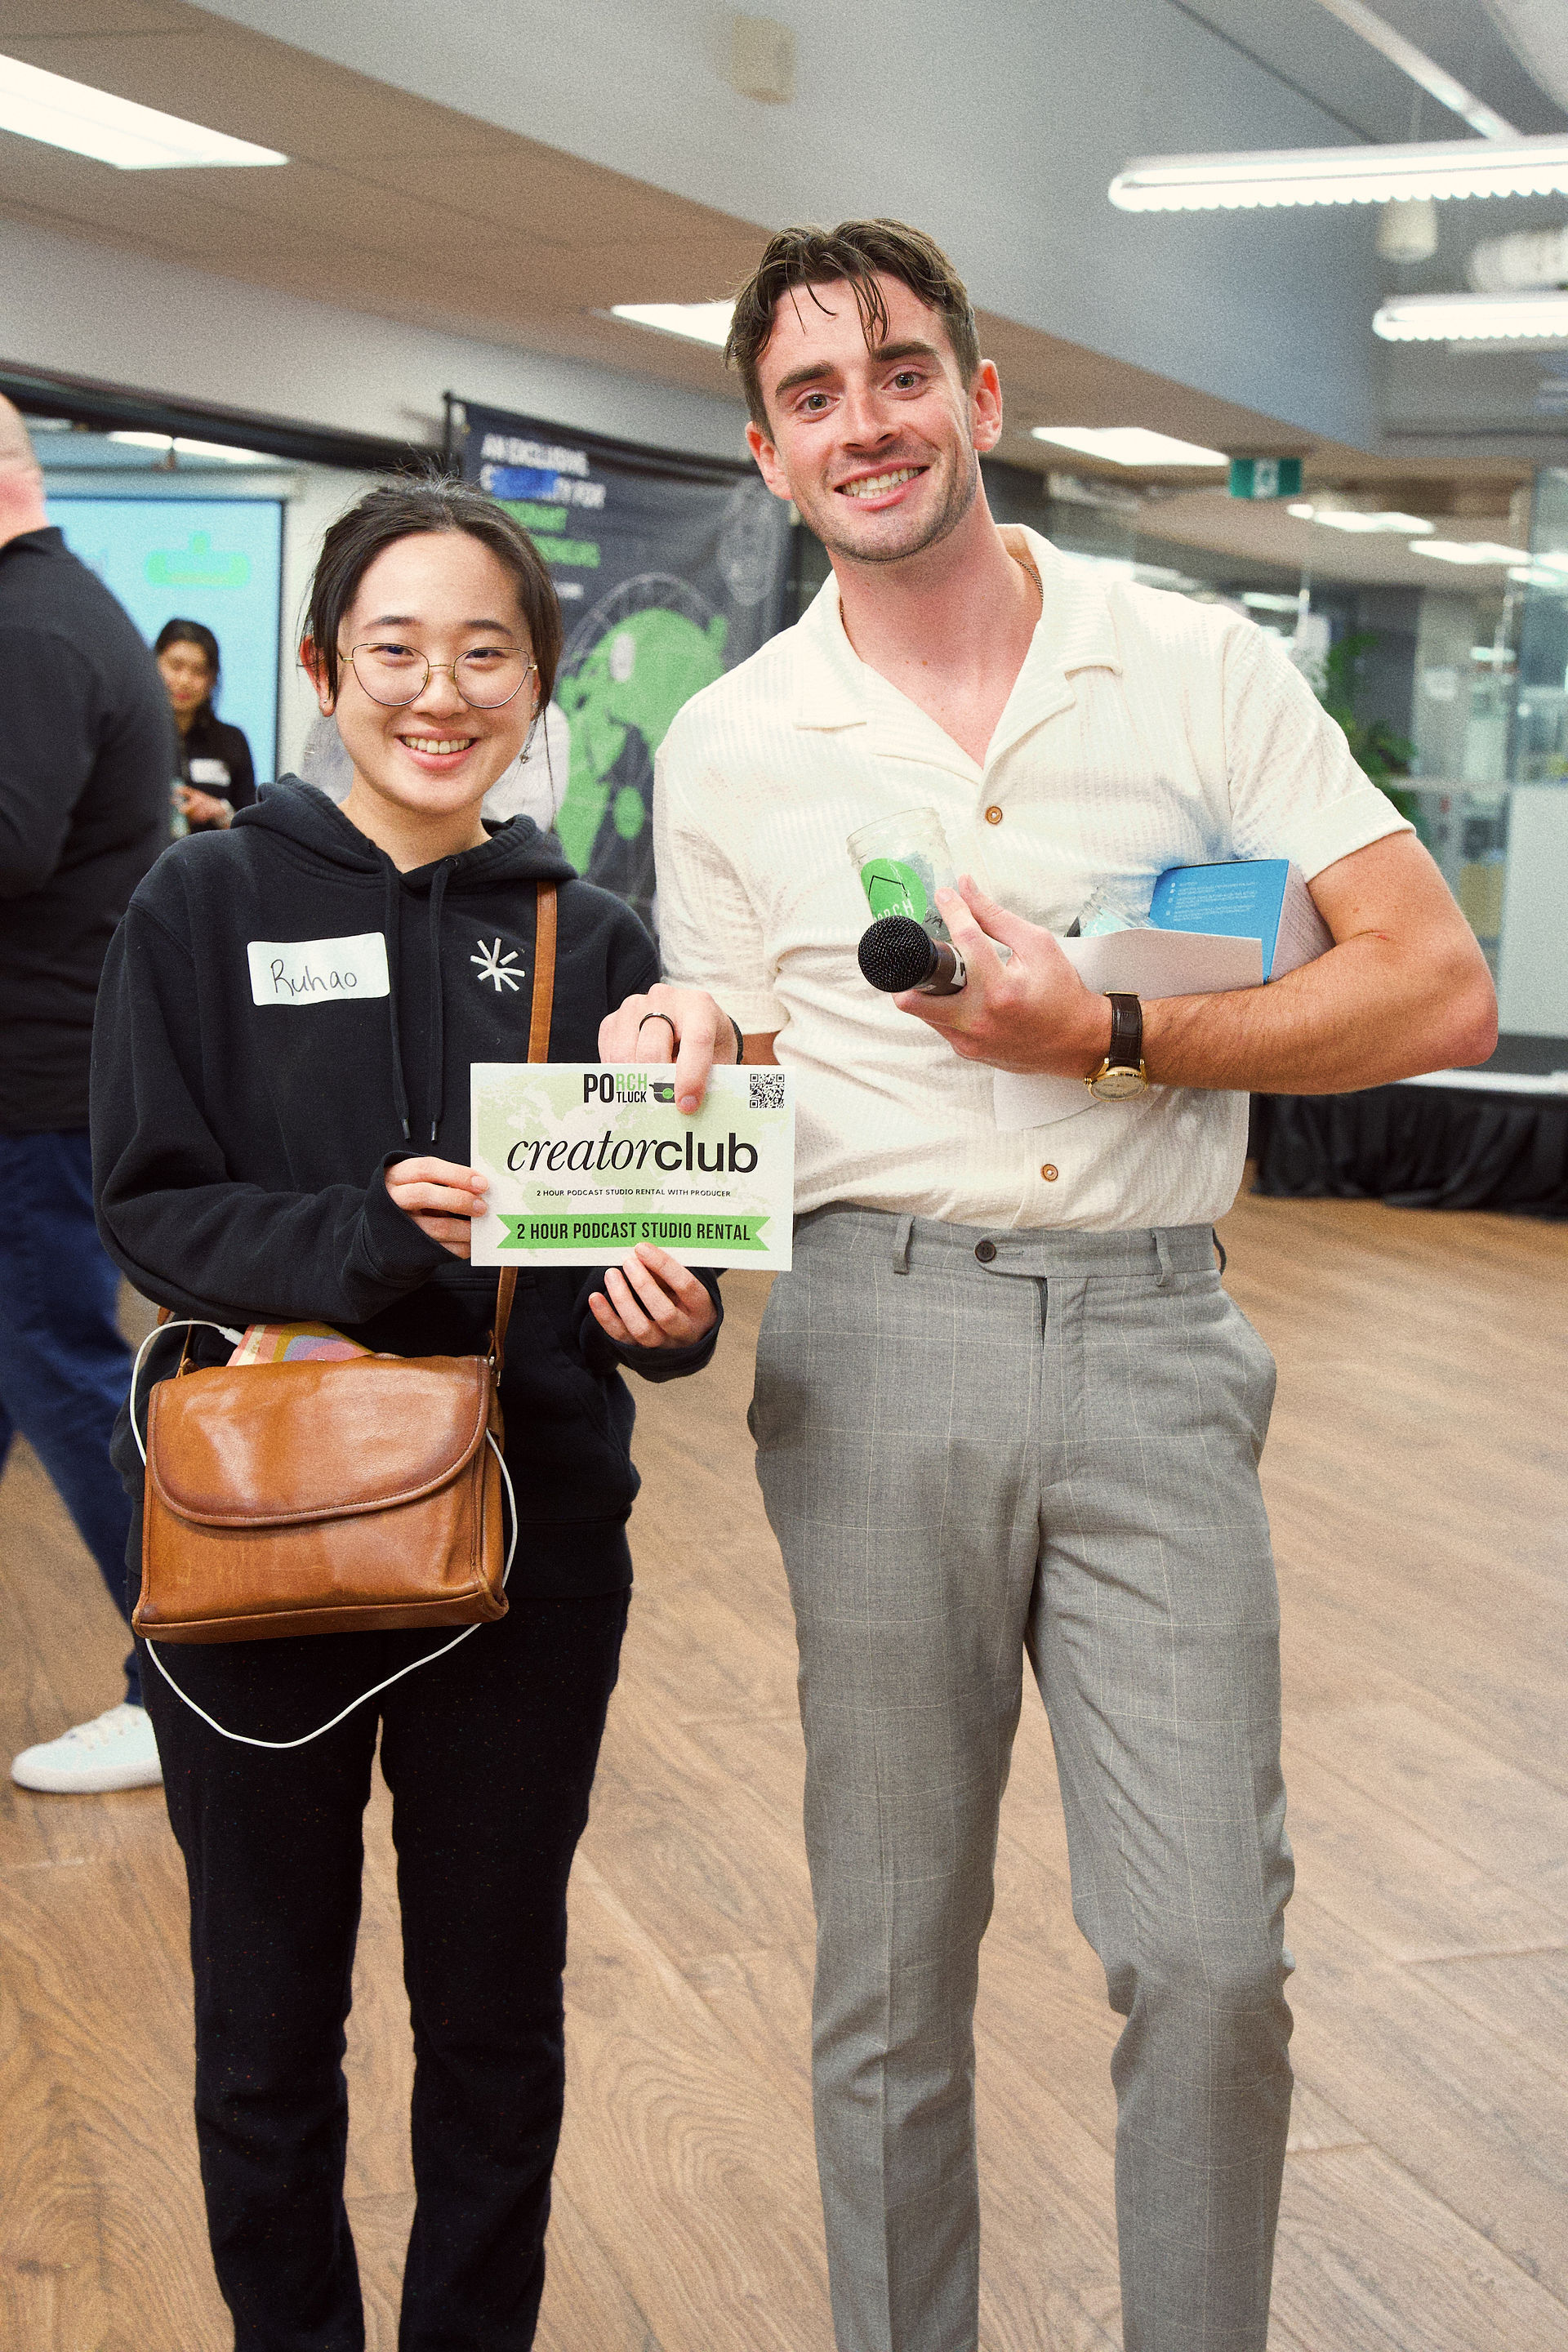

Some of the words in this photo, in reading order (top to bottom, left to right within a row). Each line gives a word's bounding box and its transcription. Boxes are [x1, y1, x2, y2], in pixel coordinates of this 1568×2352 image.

[270, 959, 358, 996] Ruhao
[690, 1189, 731, 1197] PRODUCER
[517, 1223, 525, 1240] 2
[530, 1223, 568, 1240] HOUR
[573, 1222, 637, 1239] PODCAST
[641, 1222, 692, 1239] STUDIO
[697, 1223, 751, 1241] RENTAL
